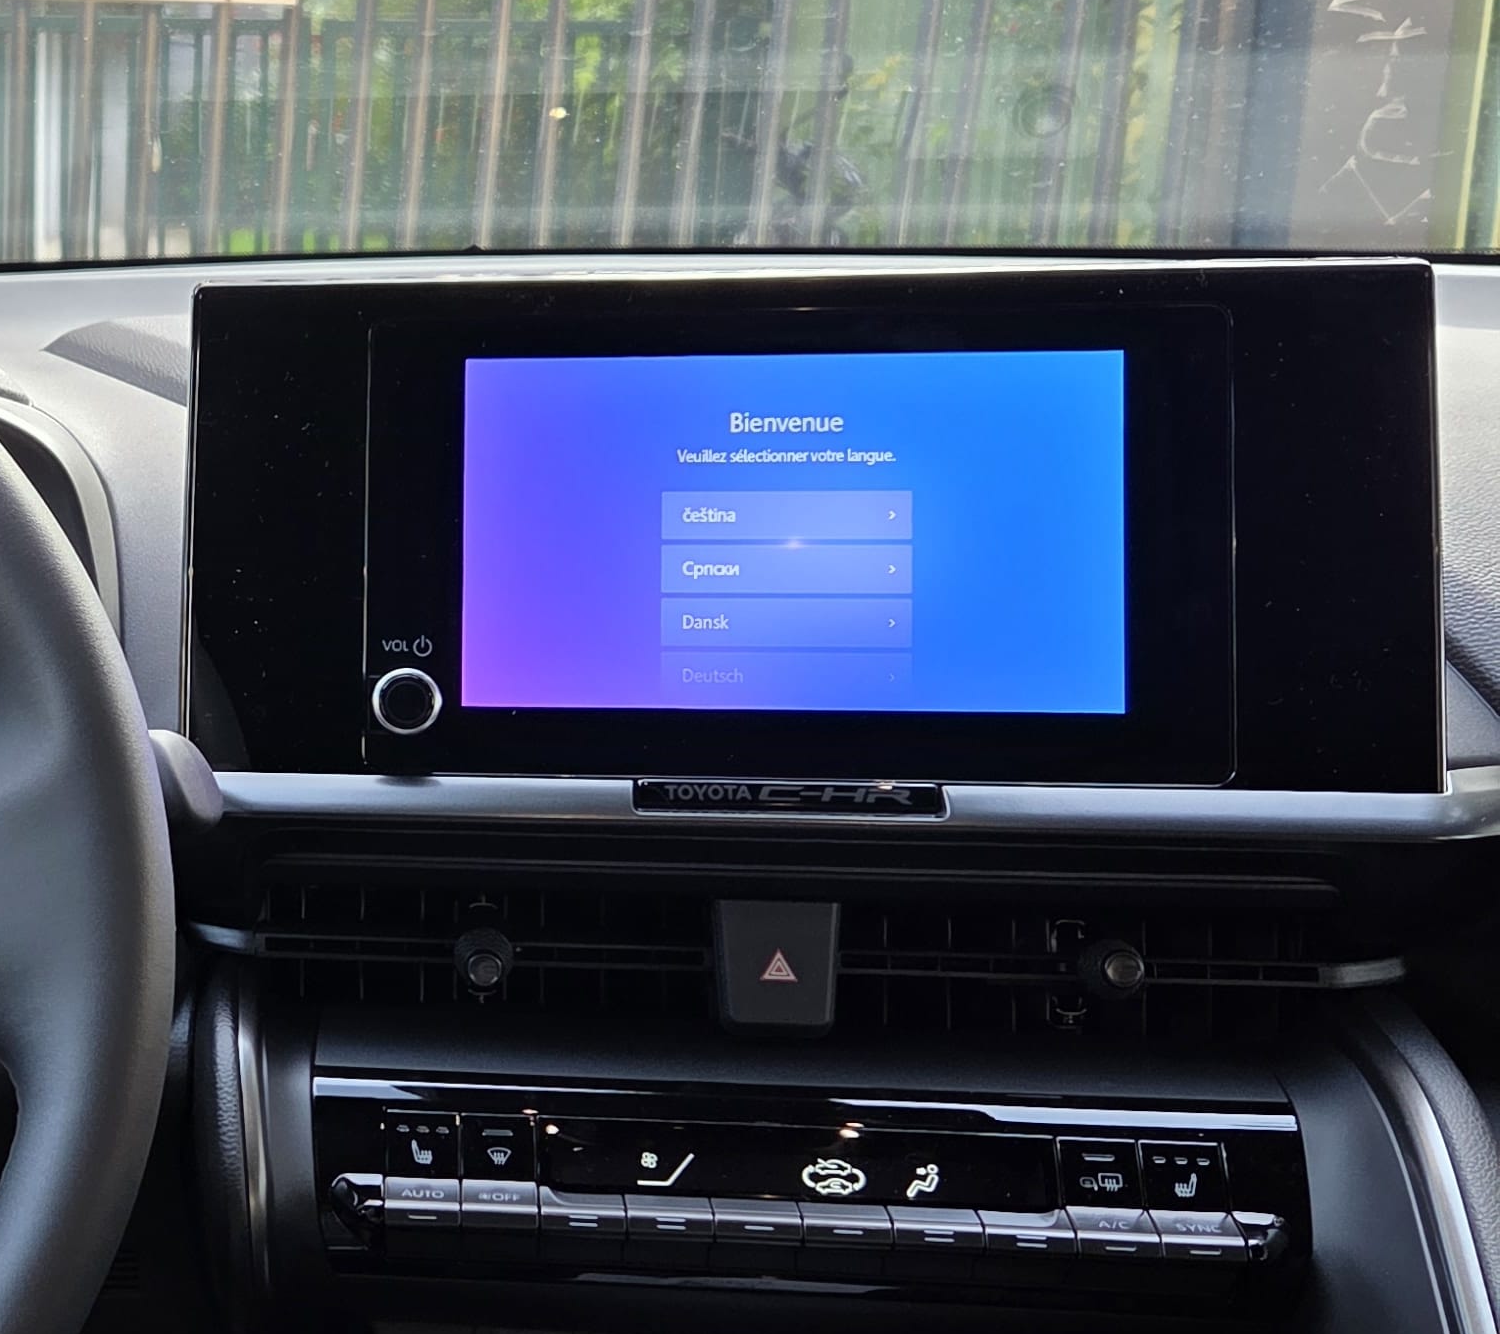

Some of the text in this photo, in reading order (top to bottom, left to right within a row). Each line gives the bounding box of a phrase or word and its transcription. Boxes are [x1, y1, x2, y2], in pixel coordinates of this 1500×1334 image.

[730, 411, 844, 435] Bienvenue
[677, 448, 896, 468] Veuillez sélectionner votre langue.
[682, 505, 737, 524] čeština
[682, 561, 740, 581] Српски
[682, 613, 729, 631] Dansk
[382, 639, 409, 652] VOL
[682, 667, 744, 685] Deutsch
[664, 784, 913, 806] TOYOTA C-HR
[401, 1188, 444, 1199] AUTO
[492, 1192, 521, 1202] OFF
[1098, 1219, 1130, 1230] A/C
[1175, 1222, 1221, 1233] SYNC
